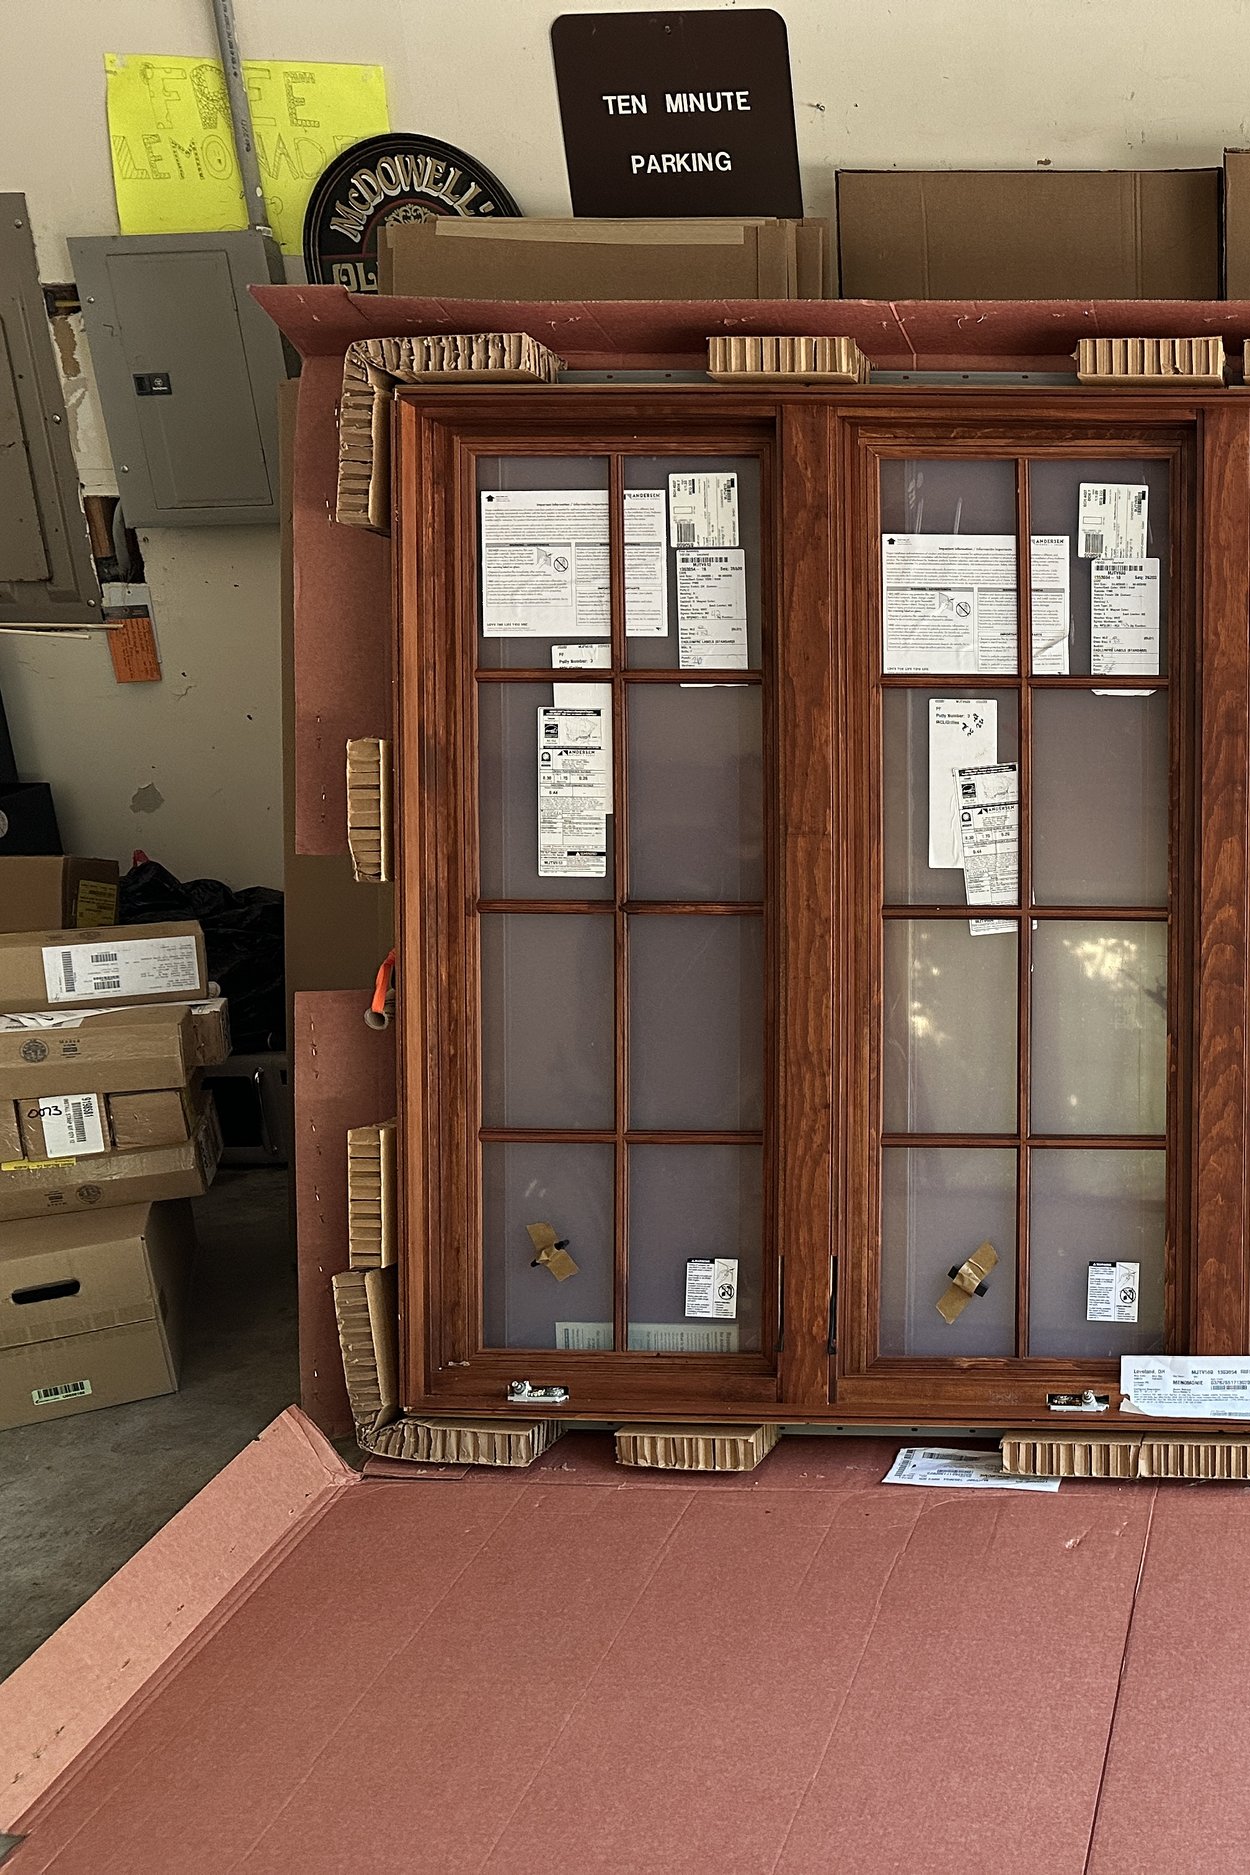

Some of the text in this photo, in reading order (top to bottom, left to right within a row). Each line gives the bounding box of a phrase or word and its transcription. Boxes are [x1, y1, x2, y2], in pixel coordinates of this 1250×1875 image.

[141, 62, 320, 130] FREE
[602, 90, 751, 115] TEN MINUTE
[631, 151, 732, 174] PARKING
